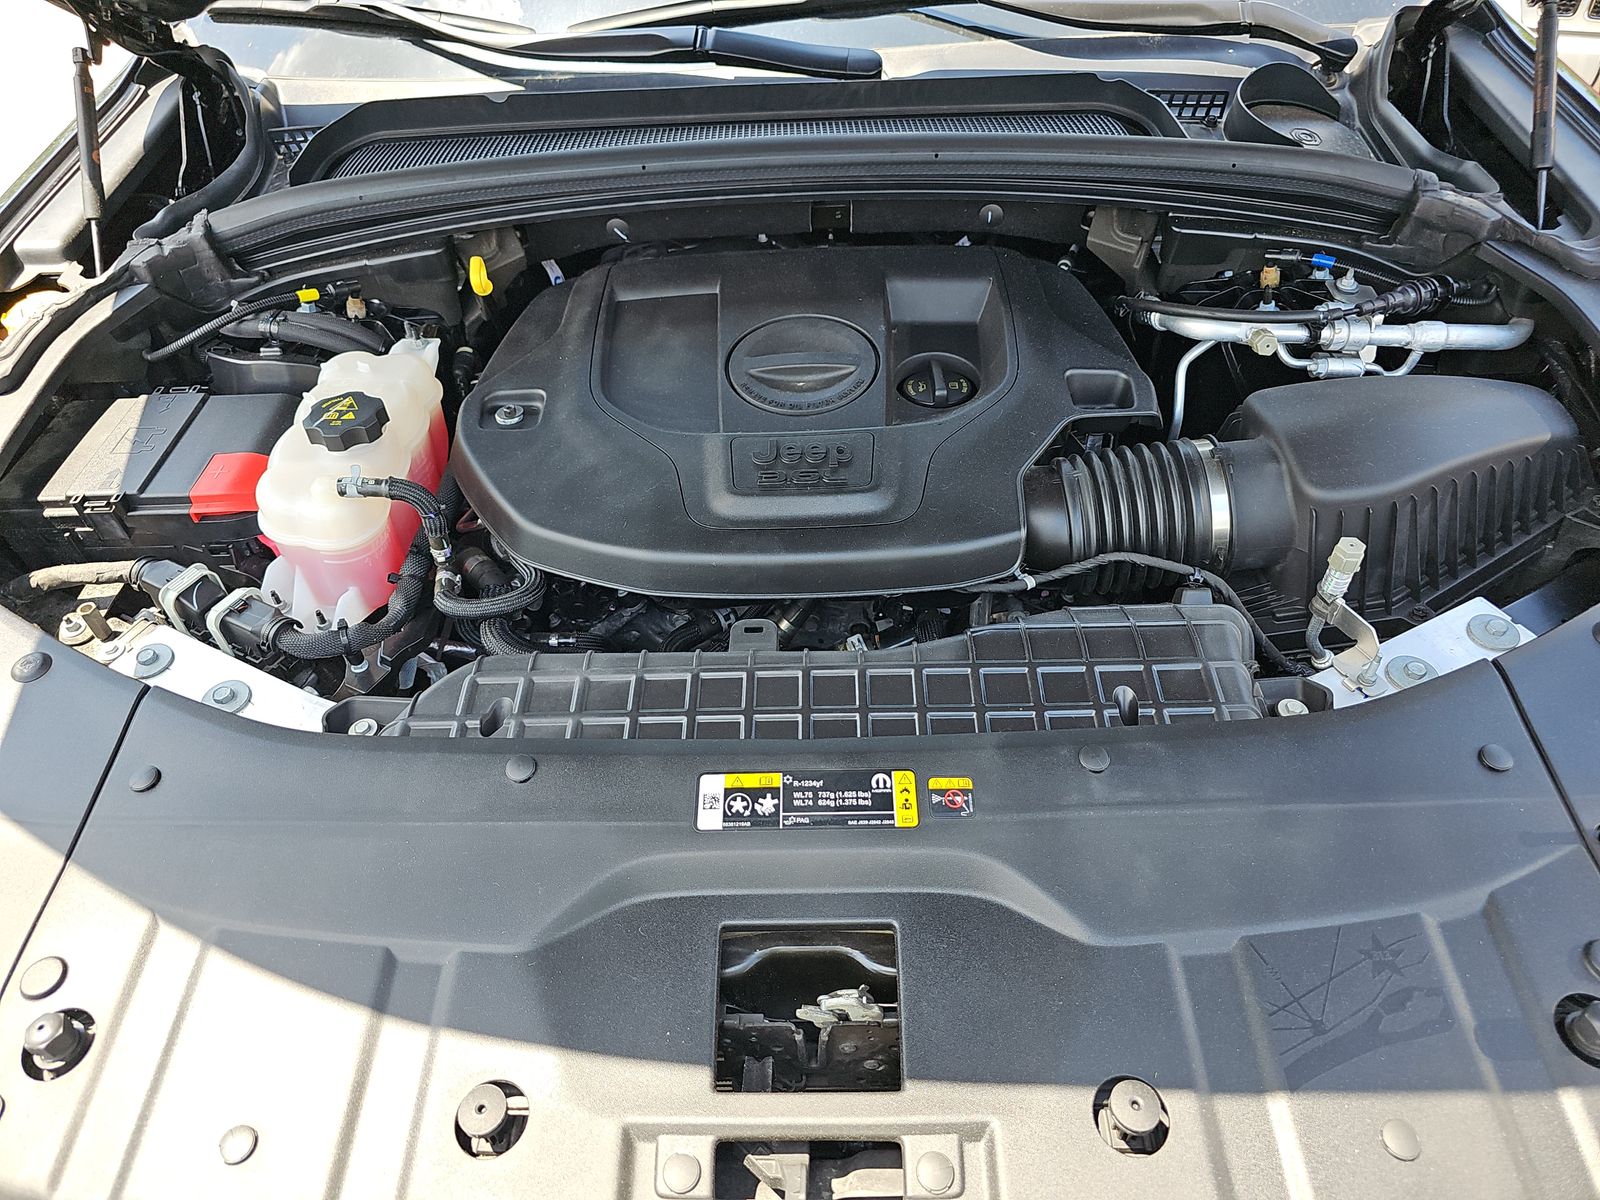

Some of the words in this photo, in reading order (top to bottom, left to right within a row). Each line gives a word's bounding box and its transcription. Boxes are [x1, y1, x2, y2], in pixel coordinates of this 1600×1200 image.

[751, 439, 854, 468] Jeep
[792, 779, 824, 788] R-1234yf
[792, 791, 813, 799] WL75
[817, 791, 835, 799] 737g
[836, 790, 857, 799] (1.625
[857, 790, 872, 799] lbs)
[792, 799, 813, 807] WL74
[817, 799, 835, 807] 624g
[836, 798, 857, 807] (1.375
[857, 798, 872, 806] lbs)
